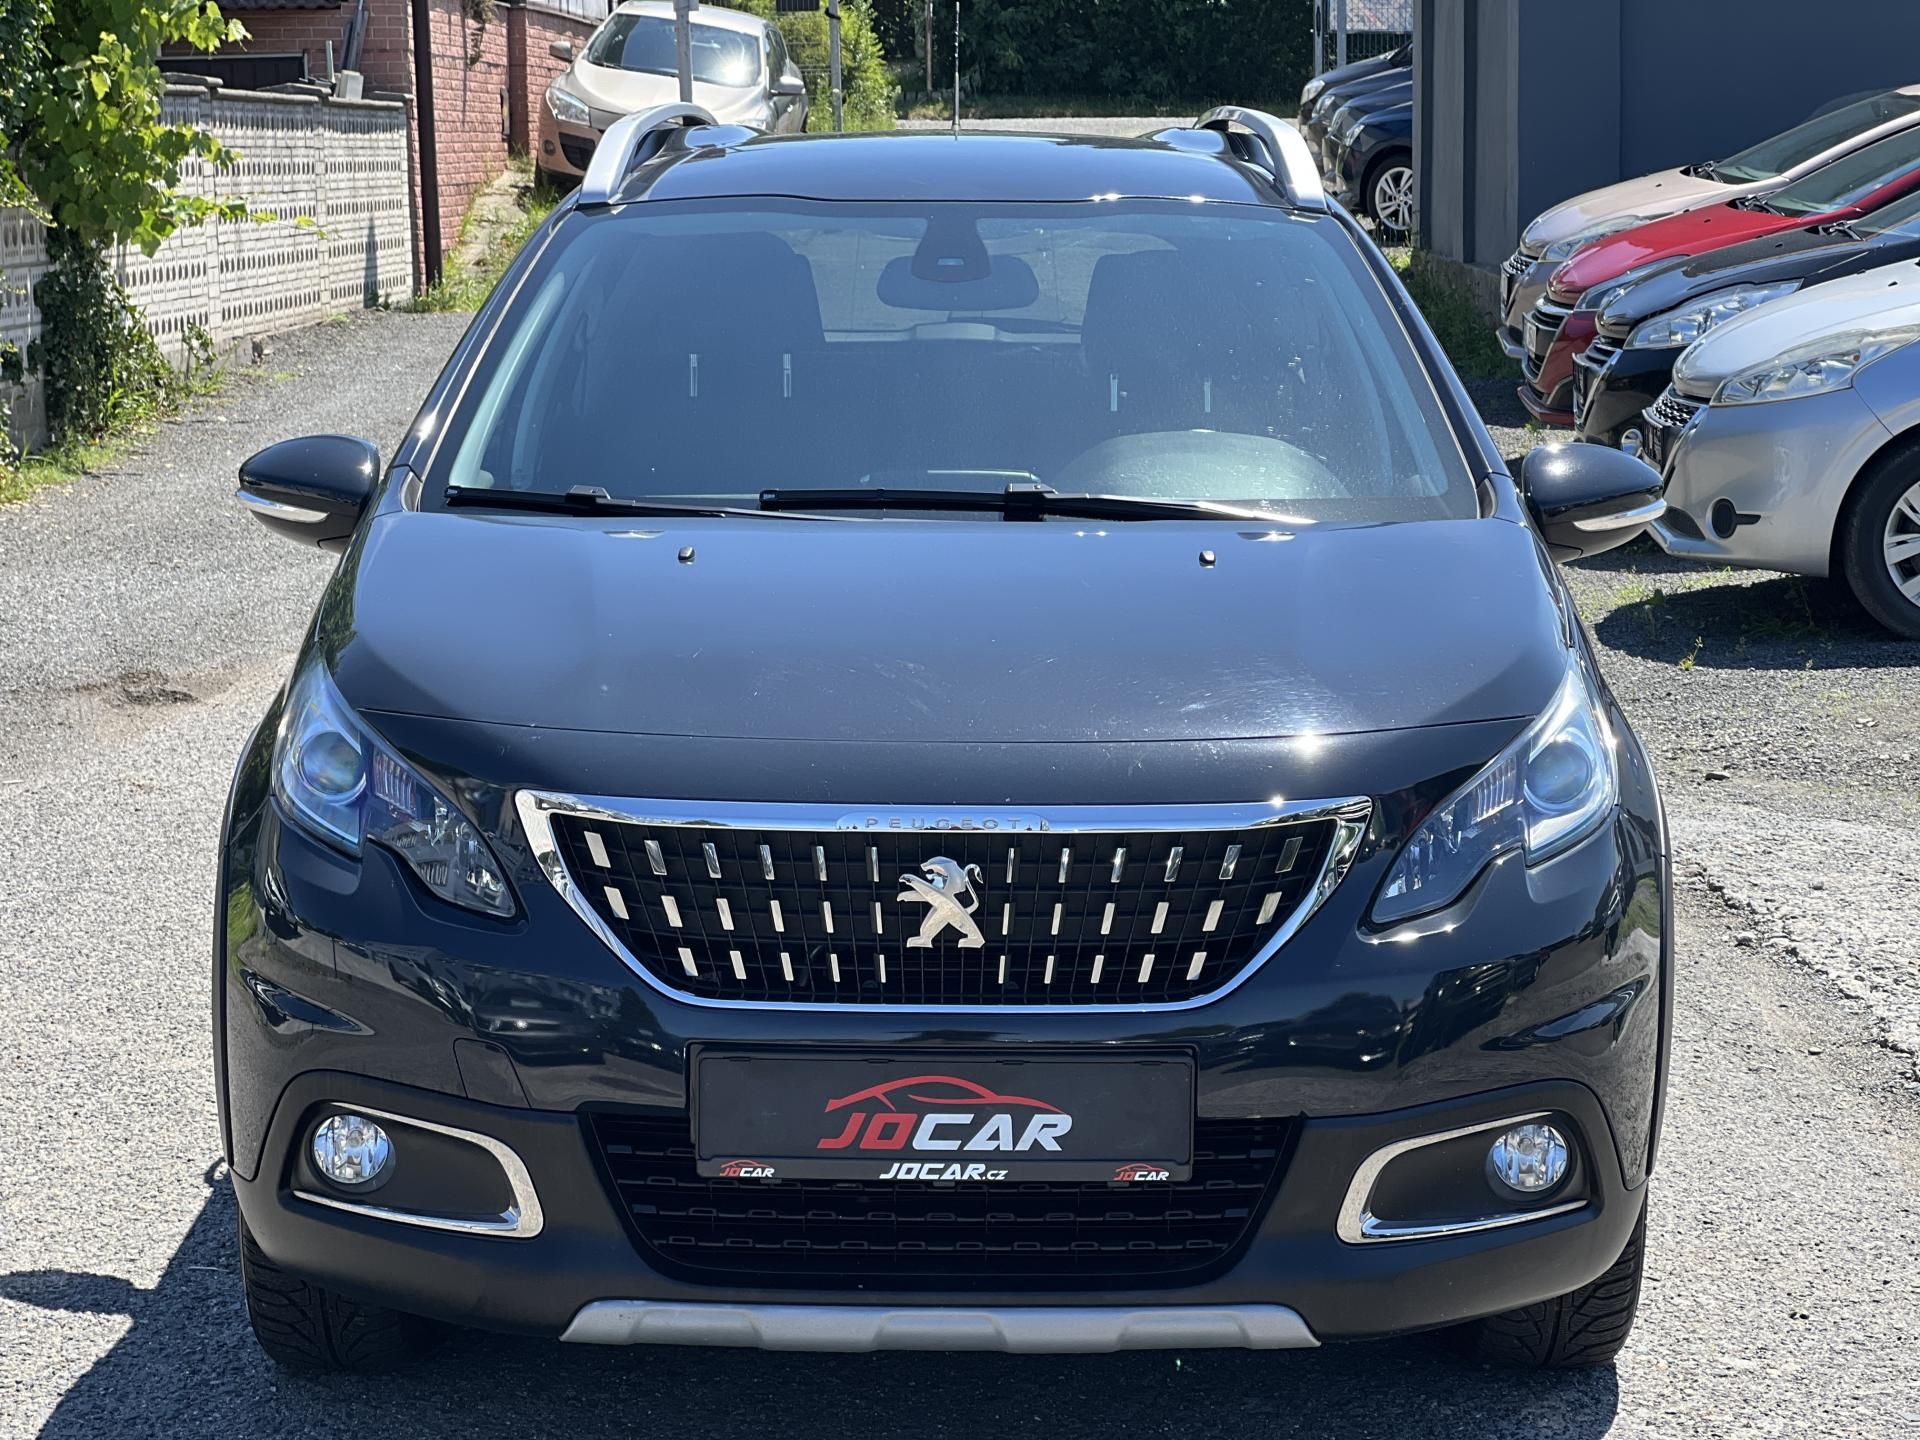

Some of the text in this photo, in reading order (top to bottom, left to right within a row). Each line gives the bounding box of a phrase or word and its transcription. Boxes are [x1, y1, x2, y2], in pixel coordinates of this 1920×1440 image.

[864, 816, 1022, 830] PEUGEOT
[816, 1112, 1073, 1151] JOCAR
[719, 1167, 775, 1178] JOCAR
[1113, 1171, 1170, 1181] JOCAR
